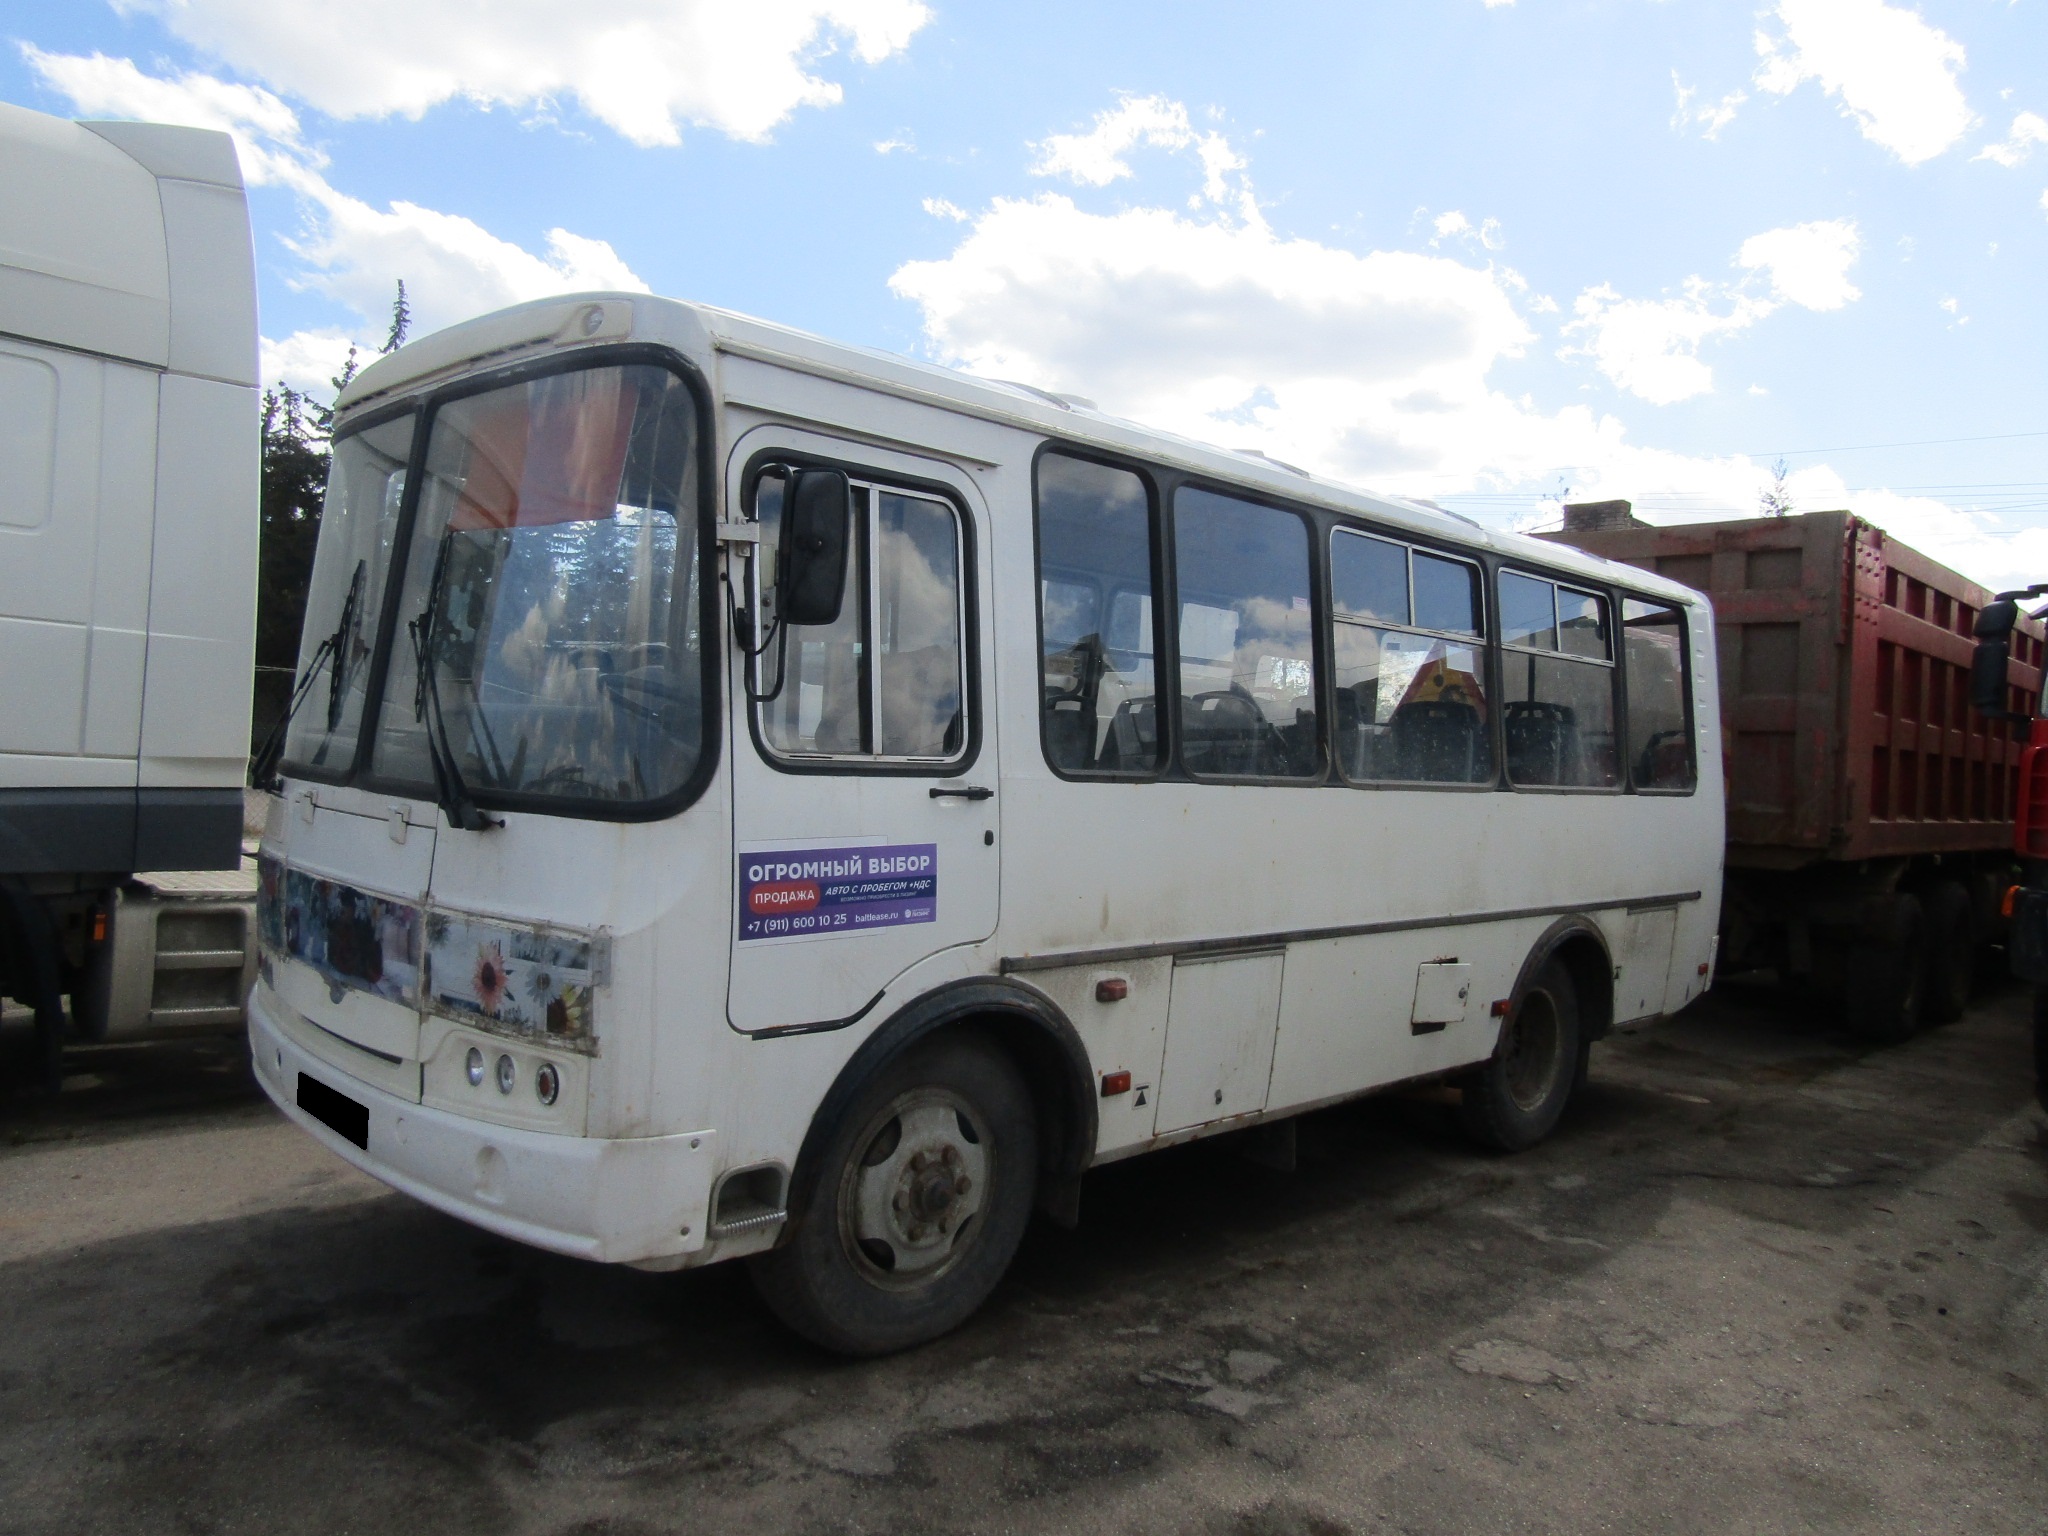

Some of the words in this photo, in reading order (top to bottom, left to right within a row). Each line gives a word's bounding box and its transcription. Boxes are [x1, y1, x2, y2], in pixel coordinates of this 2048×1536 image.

[749, 855, 862, 882] ОГРОМНЫЙ
[868, 855, 930, 874] ВЫБОР
[825, 885, 850, 896] АВТО
[851, 885, 858, 894] С
[860, 881, 907, 893] ПРОБЕГОМ
[755, 889, 815, 905] ПРОДАЖА
[747, 921, 760, 932] +7
[764, 917, 789, 934] (911)
[793, 916, 815, 929] 600
[819, 915, 830, 926] 10
[834, 913, 847, 925] 25
[855, 911, 899, 923] baltlease.ru
